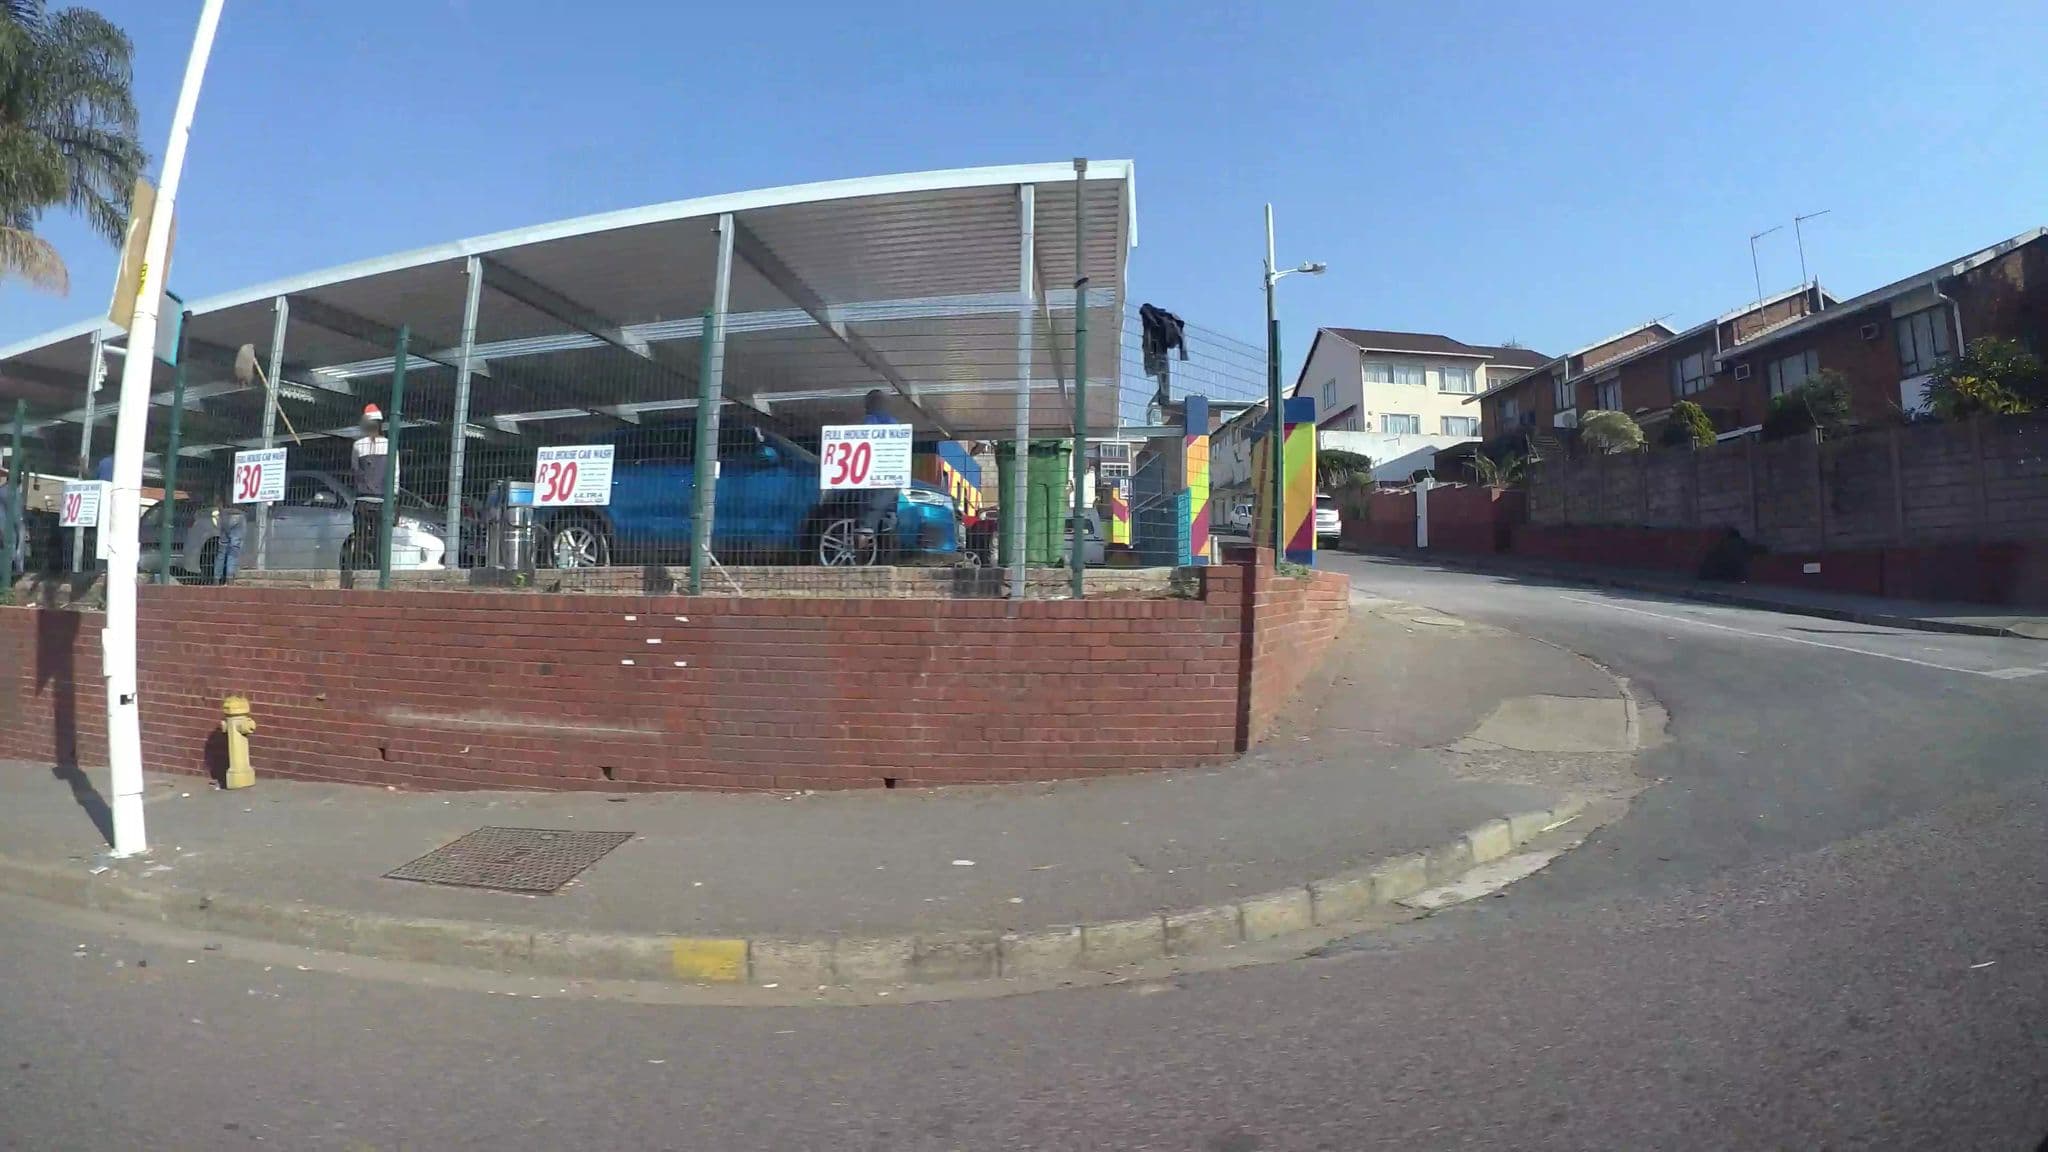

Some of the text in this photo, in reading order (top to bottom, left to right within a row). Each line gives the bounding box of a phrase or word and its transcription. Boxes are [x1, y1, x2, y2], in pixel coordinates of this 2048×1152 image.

[824, 429, 910, 440] FULL HOUSE CAR WASH
[540, 449, 612, 460] FULL HOUSE CAR WASH
[824, 442, 871, 485] R30
[537, 462, 577, 502] R30
